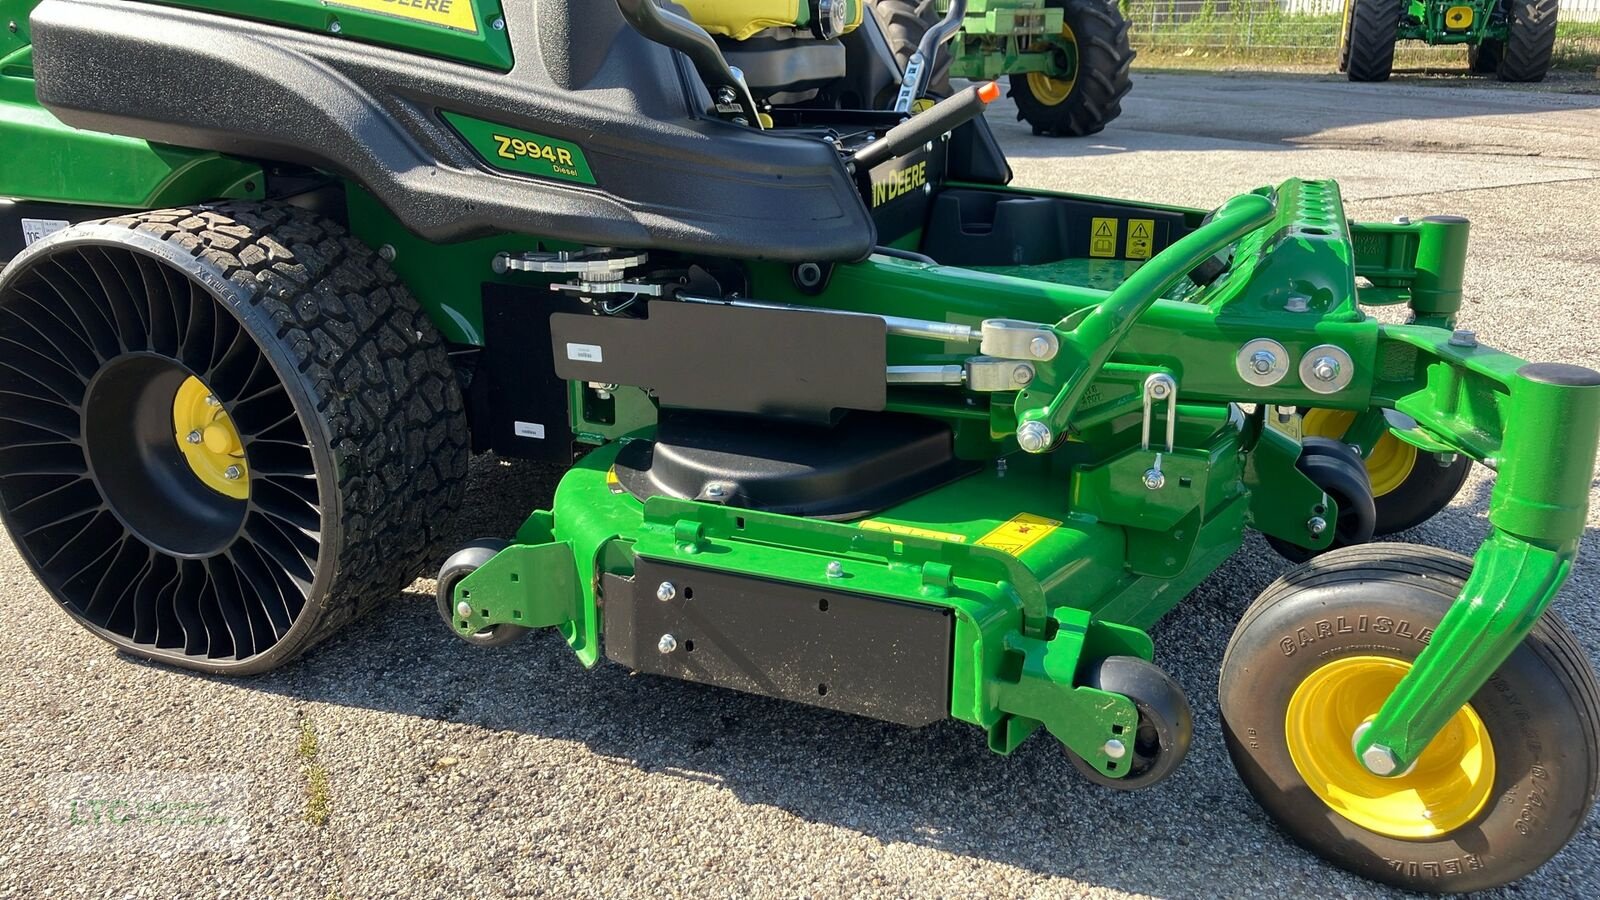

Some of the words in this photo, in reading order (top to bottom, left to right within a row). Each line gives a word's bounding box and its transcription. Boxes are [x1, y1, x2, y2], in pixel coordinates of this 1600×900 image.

[493, 134, 574, 167] Z994R
[552, 164, 578, 177] Diesel
[888, 161, 927, 200] DEERE
[1279, 614, 1435, 657] CARLISLE
